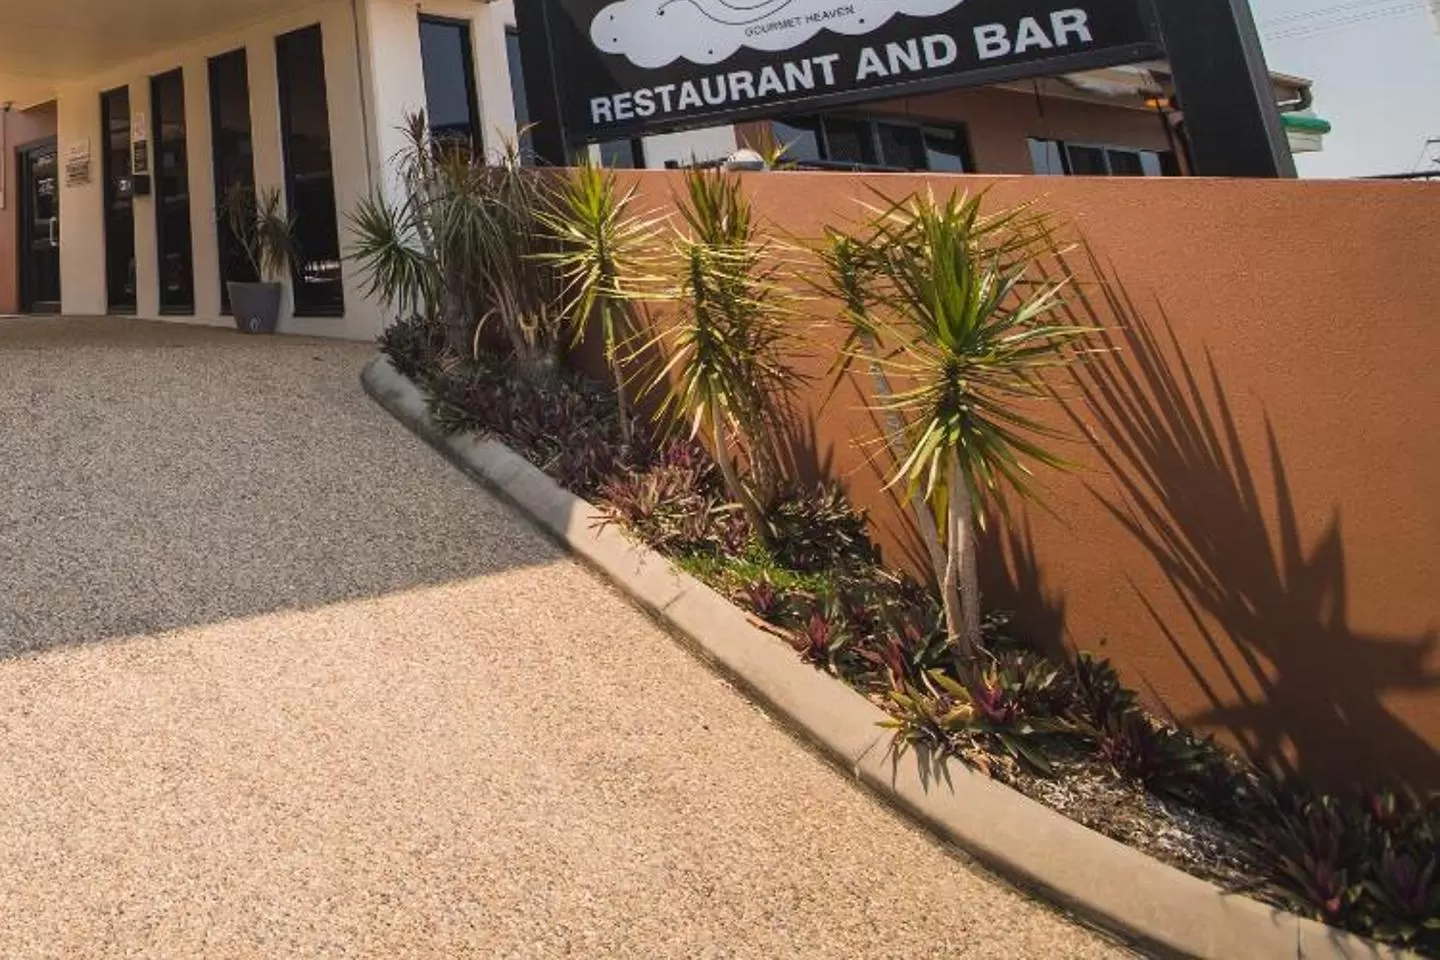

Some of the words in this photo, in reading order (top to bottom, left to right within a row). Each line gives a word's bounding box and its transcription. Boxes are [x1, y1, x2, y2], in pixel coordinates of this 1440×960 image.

[744, 16, 801, 38] GOURMET
[805, 4, 856, 24] HEAVEN
[590, 53, 840, 124] RESTAURANT
[855, 33, 957, 81] AND
[972, 8, 1094, 61] BAR
